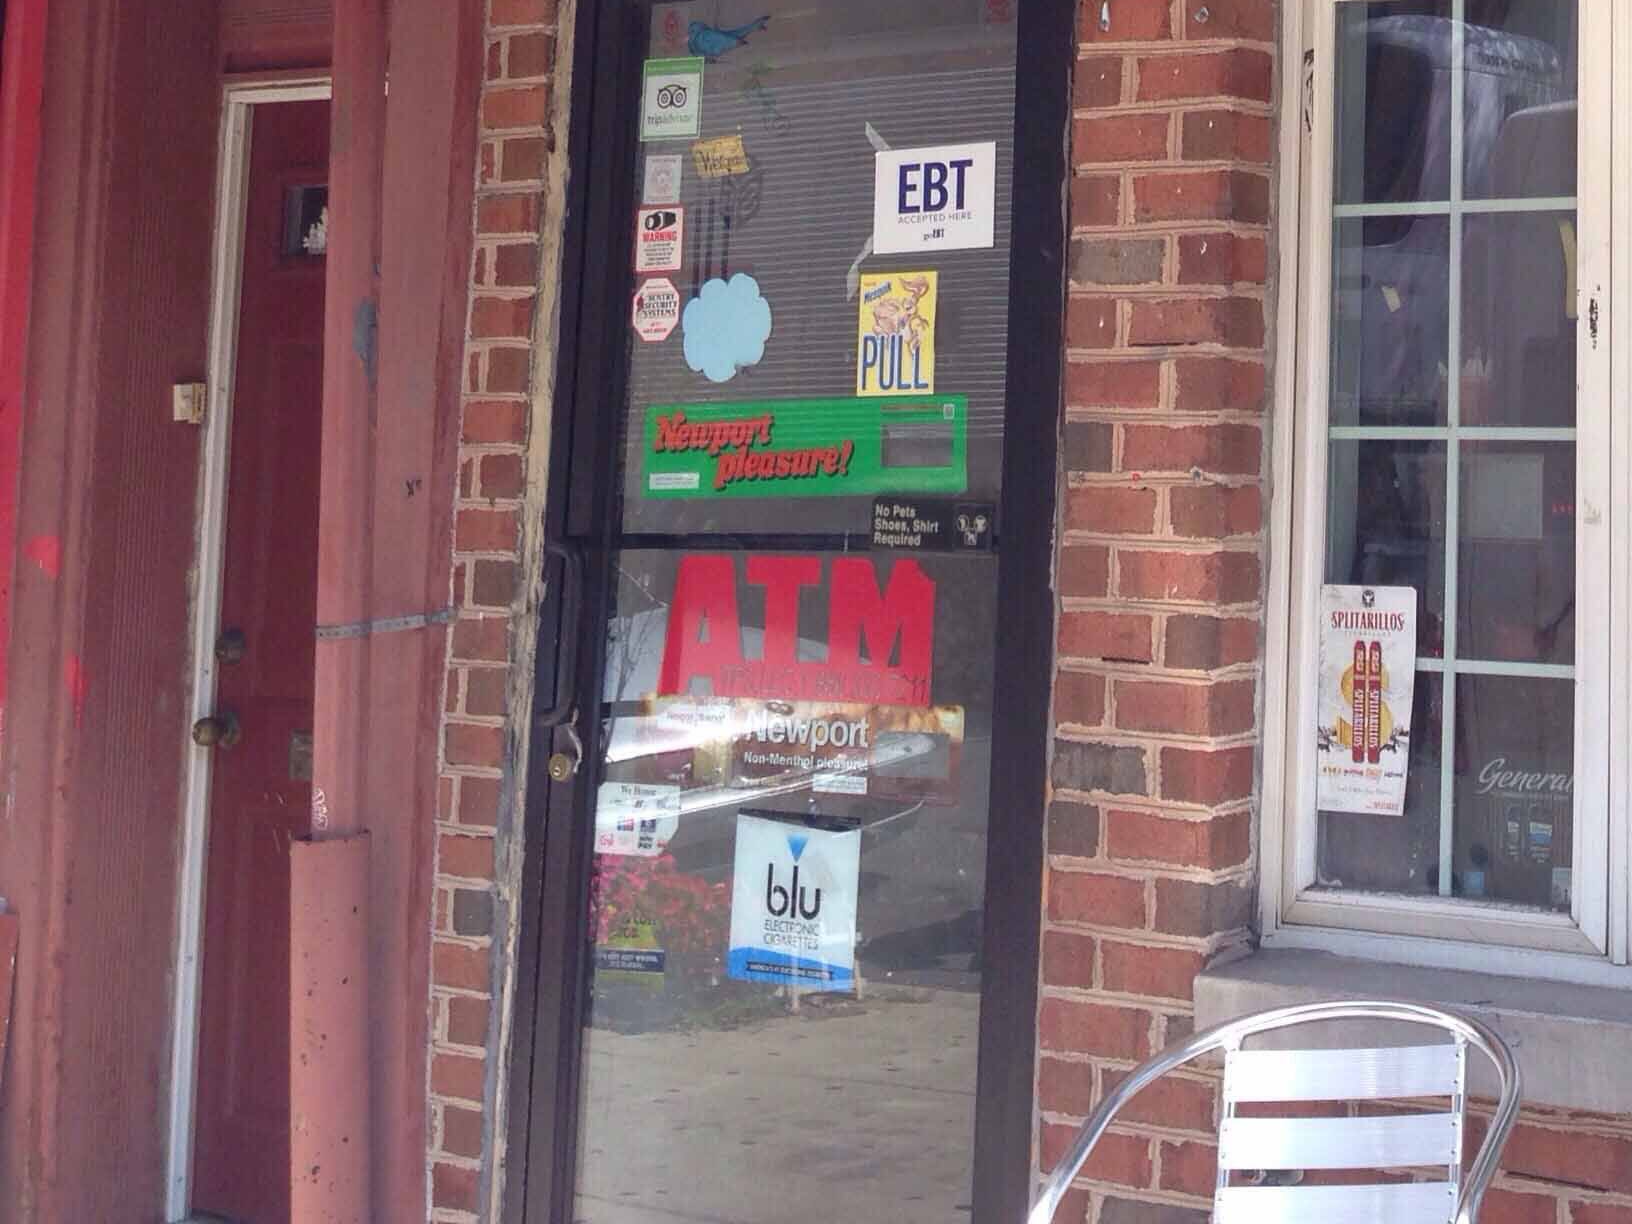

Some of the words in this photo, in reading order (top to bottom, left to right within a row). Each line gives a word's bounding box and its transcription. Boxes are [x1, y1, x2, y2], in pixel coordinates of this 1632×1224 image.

[897, 159, 973, 214] EBT
[898, 214, 946, 225] ACCEPTED
[948, 211, 973, 222] HERE
[643, 231, 677, 242] WARNING
[861, 334, 929, 391] PULL
[654, 411, 774, 456] Newport
[711, 439, 855, 492] pleasure!
[875, 504, 890, 517] No
[893, 504, 916, 518] Pets
[874, 517, 909, 533] Shoes,
[913, 519, 939, 532] Shirt
[874, 533, 921, 547] Required
[657, 556, 936, 706] ATM
[1331, 610, 1405, 632] SPLITARILLOS
[746, 710, 869, 753] Newport
[744, 751, 815, 769] Non-Menthol
[766, 863, 821, 920] blu
[764, 919, 819, 936] ELECTRONIC
[763, 934, 819, 950] CIGARETTES
